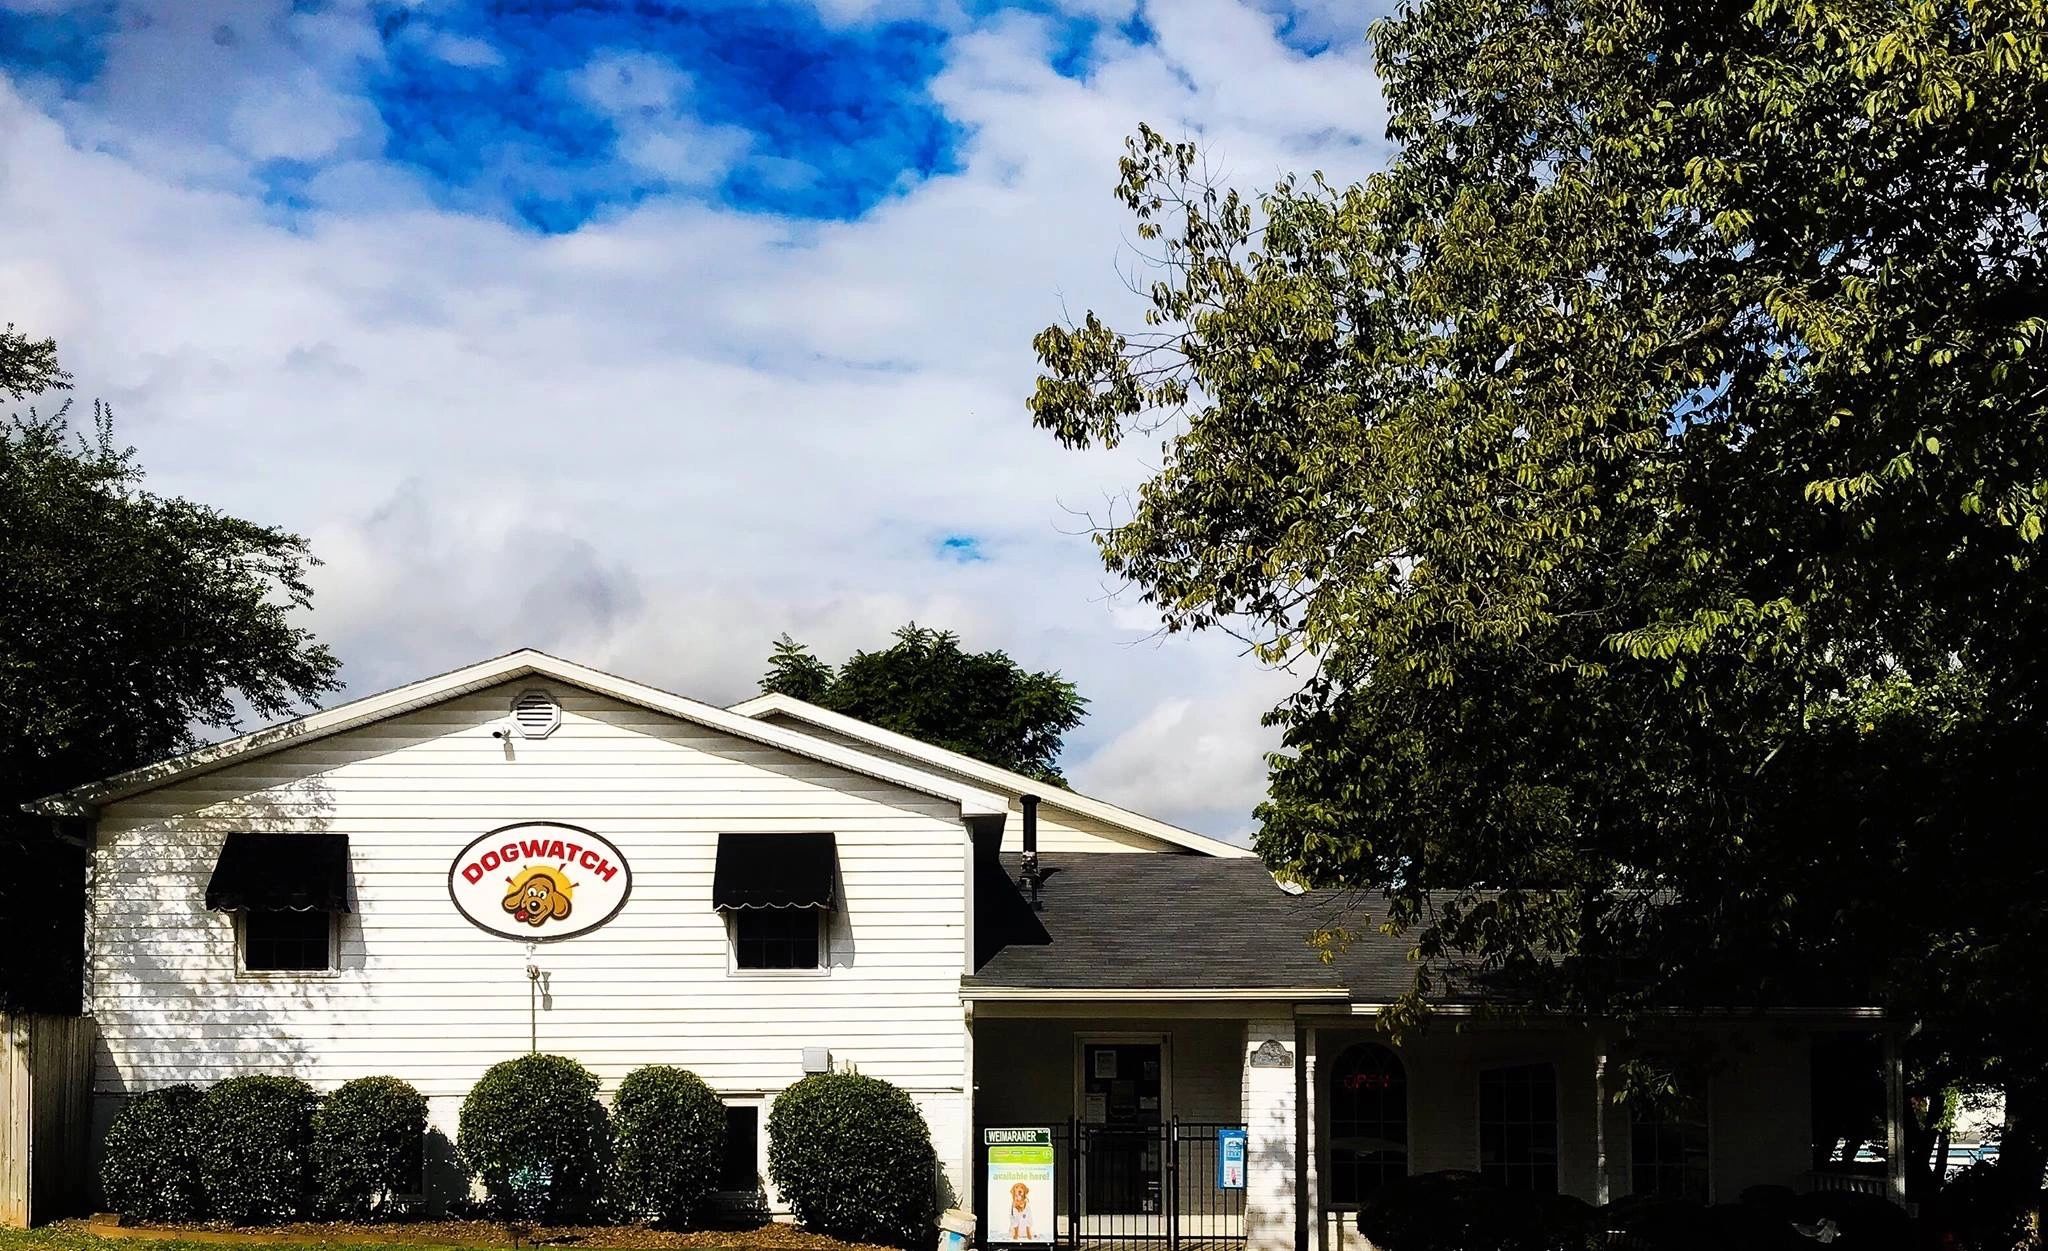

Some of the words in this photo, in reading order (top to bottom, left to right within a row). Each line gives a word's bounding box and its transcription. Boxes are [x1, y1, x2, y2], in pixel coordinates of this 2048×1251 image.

[462, 840, 618, 885] DOGWATCH
[1343, 1073, 1392, 1089] OPEN
[988, 1130, 1037, 1142] WEIMARANER
[993, 1172, 1027, 1181] available
[1029, 1172, 1050, 1181] here!
